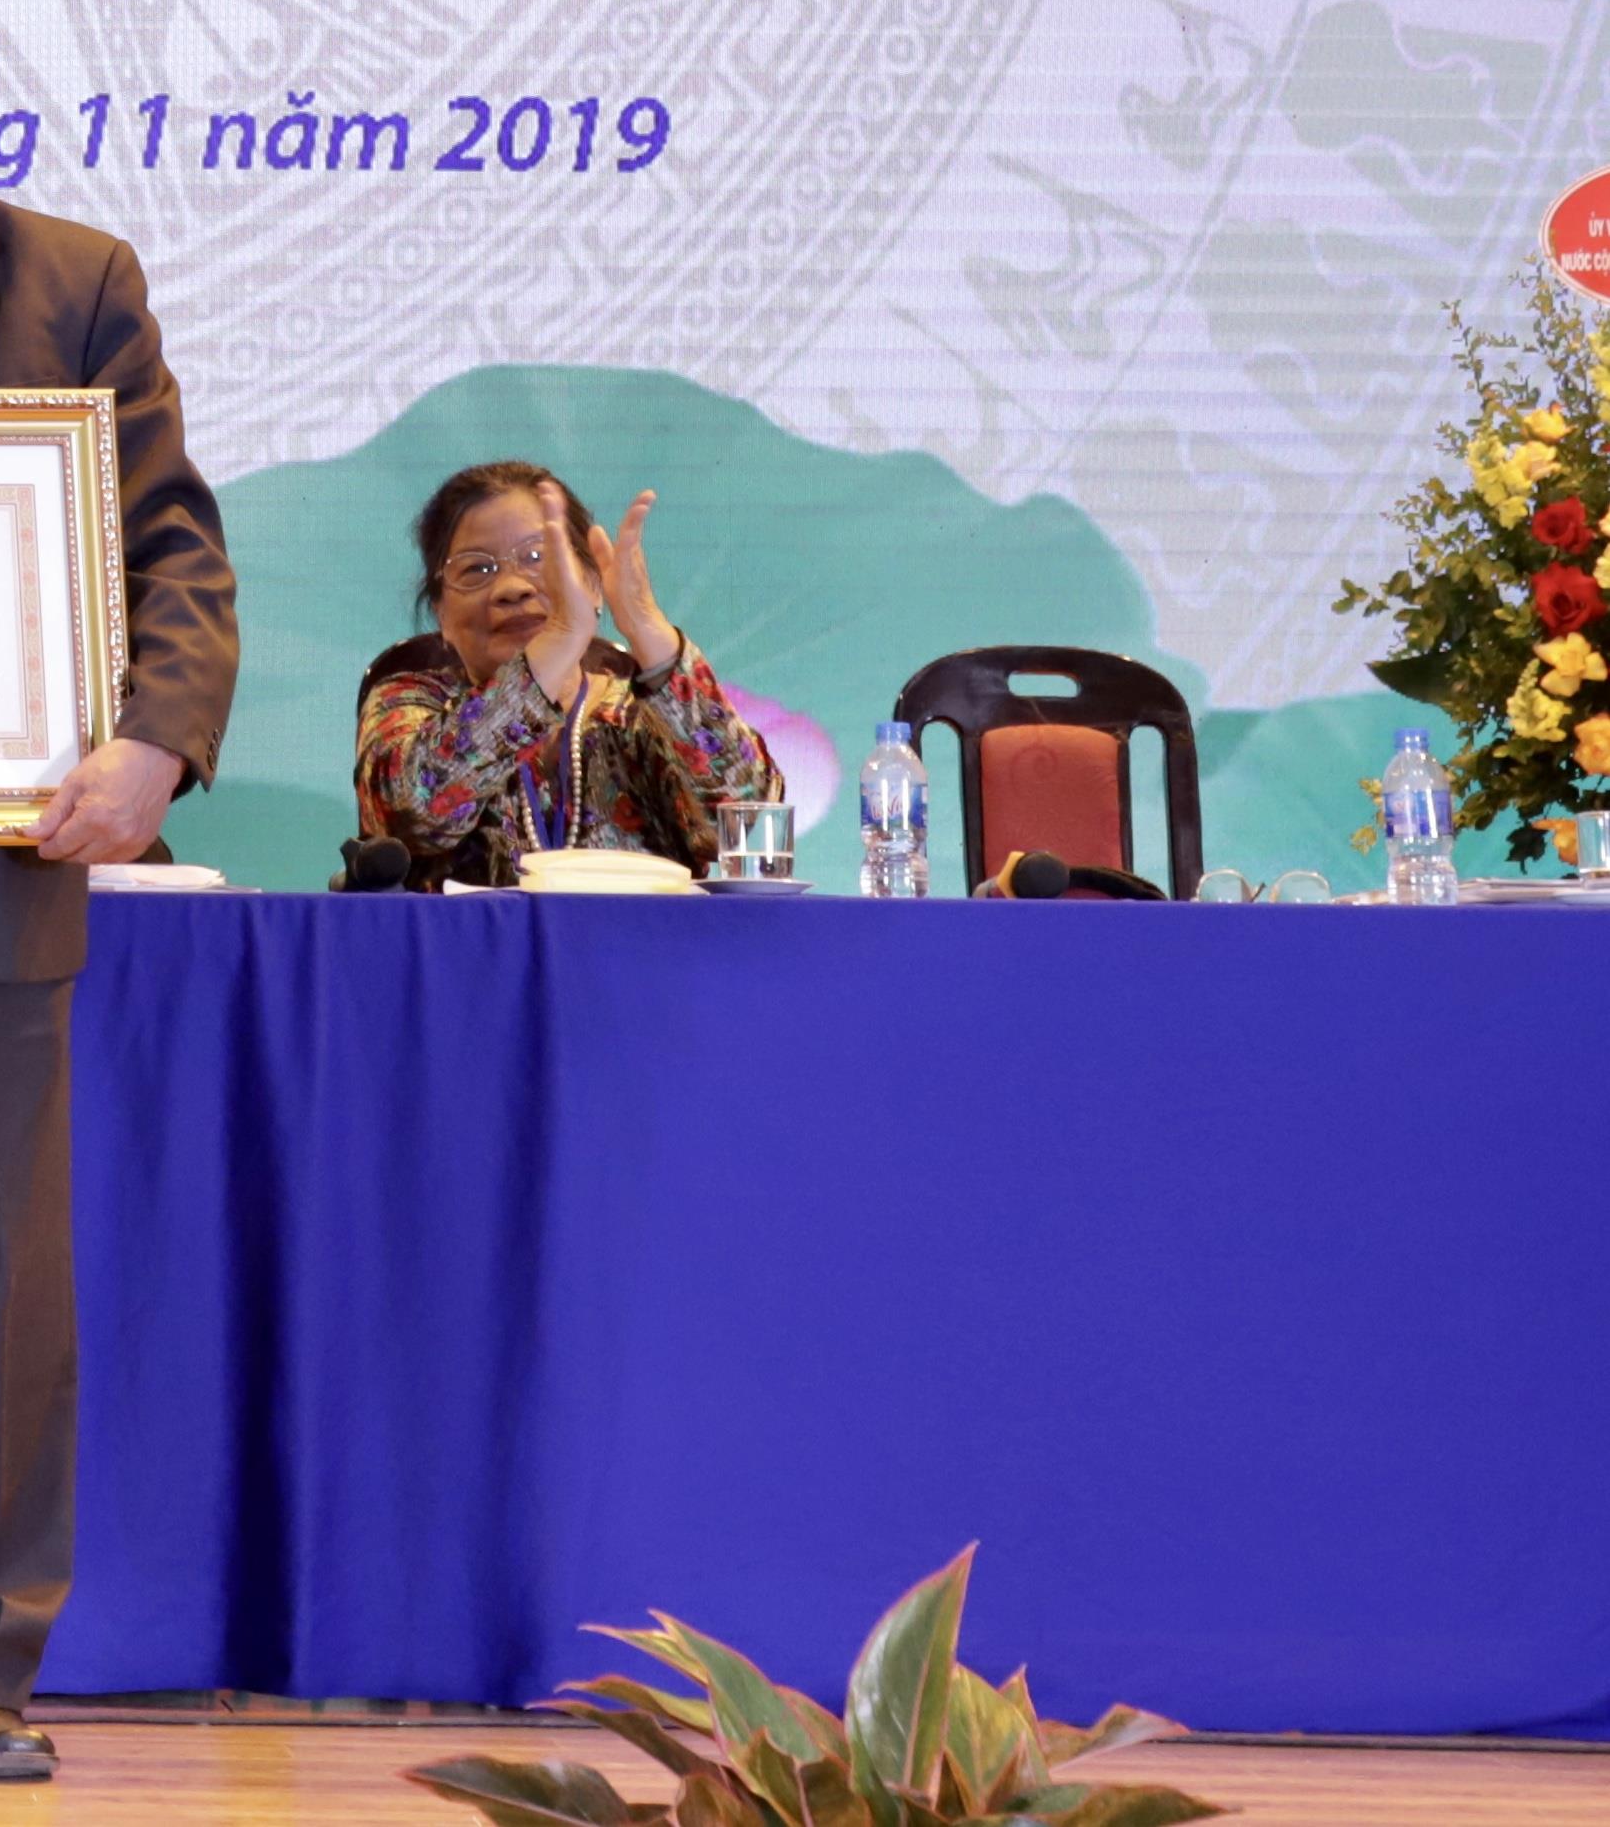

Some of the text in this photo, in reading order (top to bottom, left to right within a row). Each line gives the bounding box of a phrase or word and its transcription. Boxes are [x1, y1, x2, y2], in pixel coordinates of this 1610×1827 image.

[79, 94, 170, 169] 11
[202, 92, 411, 172] năm
[435, 96, 671, 174] 2019
